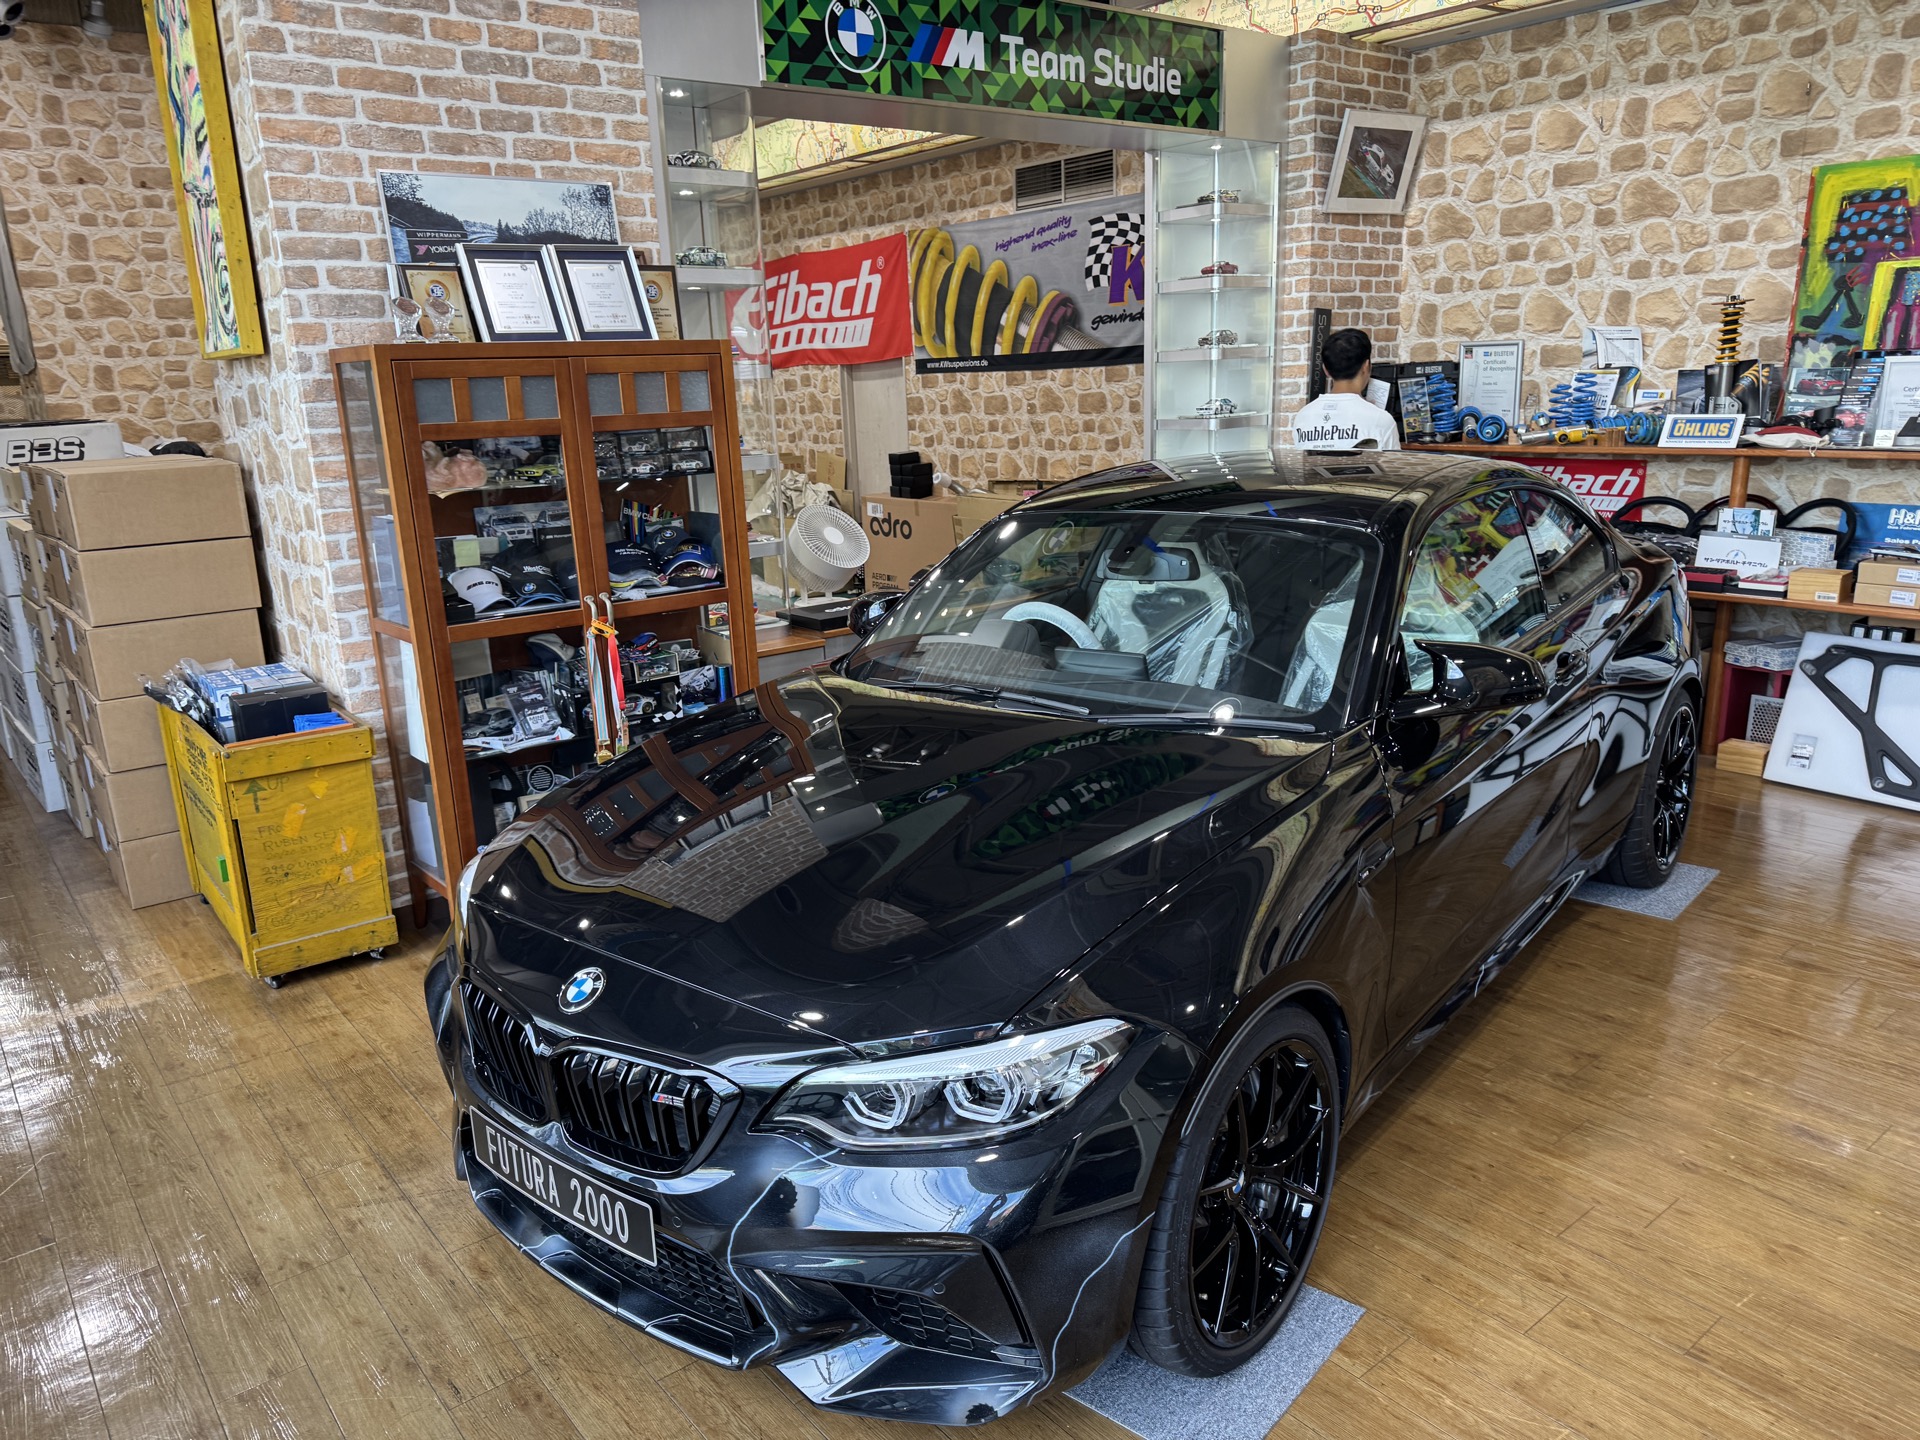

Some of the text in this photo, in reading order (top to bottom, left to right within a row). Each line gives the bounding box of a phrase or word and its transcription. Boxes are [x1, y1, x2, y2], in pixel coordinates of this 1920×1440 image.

[1001, 34, 1086, 83] Team
[1094, 47, 1181, 95] Studie
[995, 216, 1072, 252] highend quality
[1031, 229, 1078, 252] inox-line
[731, 258, 882, 355] Eibach
[926, 359, 989, 369] www.KWsuspensions.de
[1425, 365, 1443, 374] BILSTEIN
[1673, 419, 1730, 437] ÖHLINS
[6, 436, 86, 466] BBS
[870, 512, 913, 540] adro
[872, 572, 887, 581] AERO
[266, 776, 289, 792] UP
[262, 836, 308, 852] RUBEN
[486, 1125, 629, 1244] FUTURA 2000
